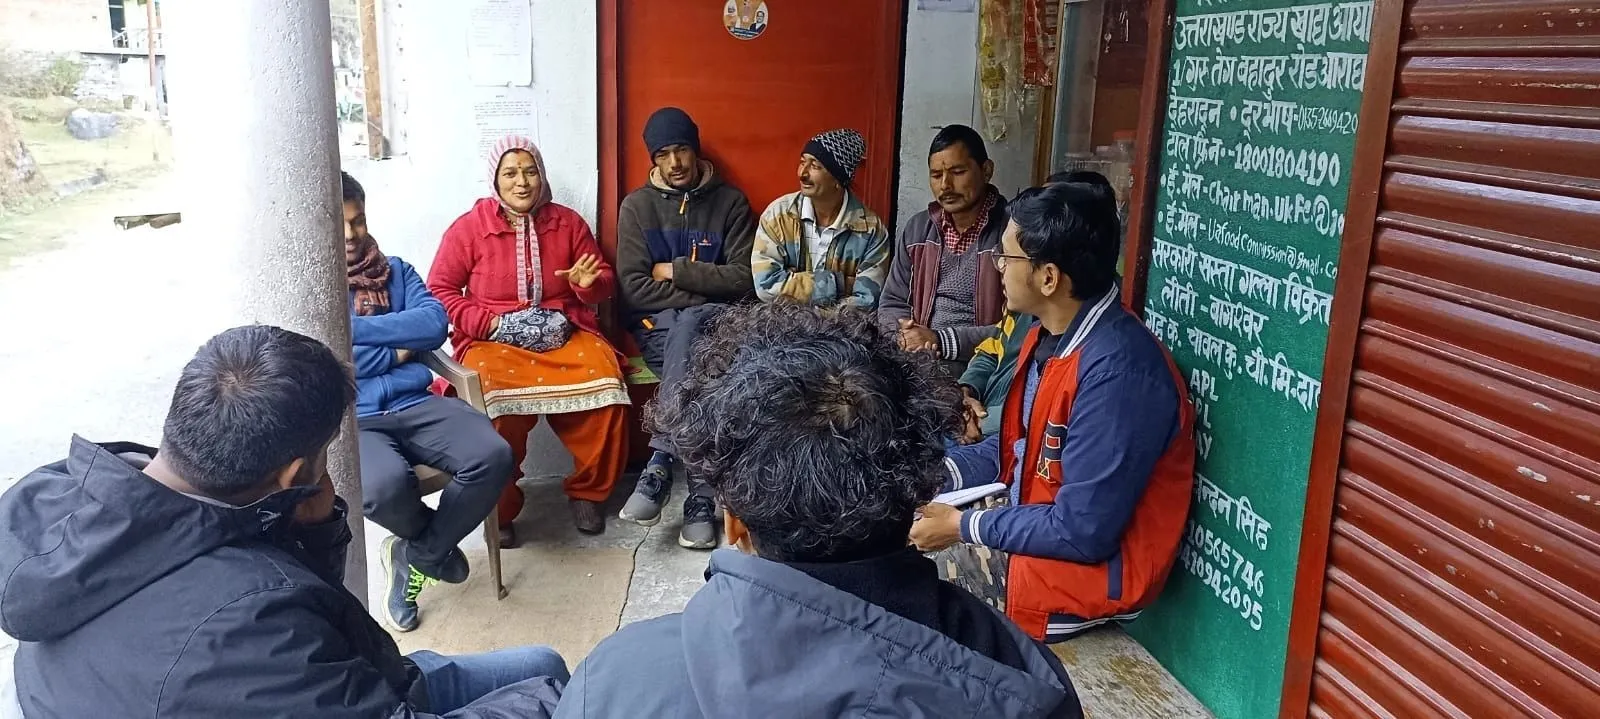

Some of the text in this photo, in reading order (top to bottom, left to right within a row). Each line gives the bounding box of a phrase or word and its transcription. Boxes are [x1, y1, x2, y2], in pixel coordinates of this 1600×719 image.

[1248, 7, 1290, 43] राज्य
[1152, 236, 1199, 279] सरकारी
[1198, 251, 1239, 293] सस्ता
[1238, 263, 1282, 310] गल्ला
[1190, 368, 1219, 402] APL
[1186, 519, 1264, 598] 10565746
